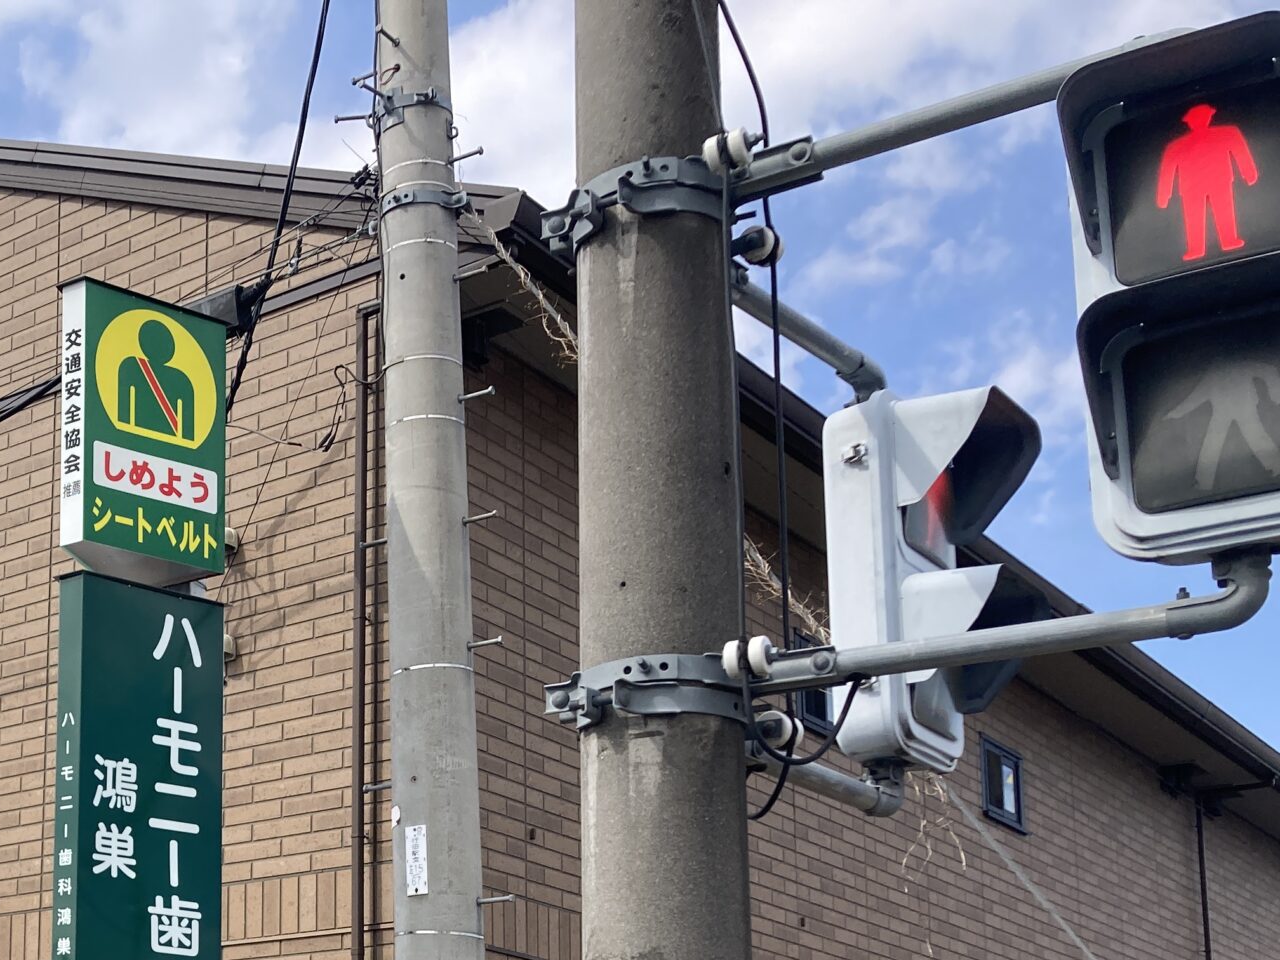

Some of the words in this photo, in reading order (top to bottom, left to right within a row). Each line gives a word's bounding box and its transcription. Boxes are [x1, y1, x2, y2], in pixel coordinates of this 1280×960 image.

[63, 327, 83, 475] 交通安全協会
[104, 450, 209, 504] しめよう
[92, 496, 218, 559] シートベルト
[91, 753, 139, 880] 鴻巣
